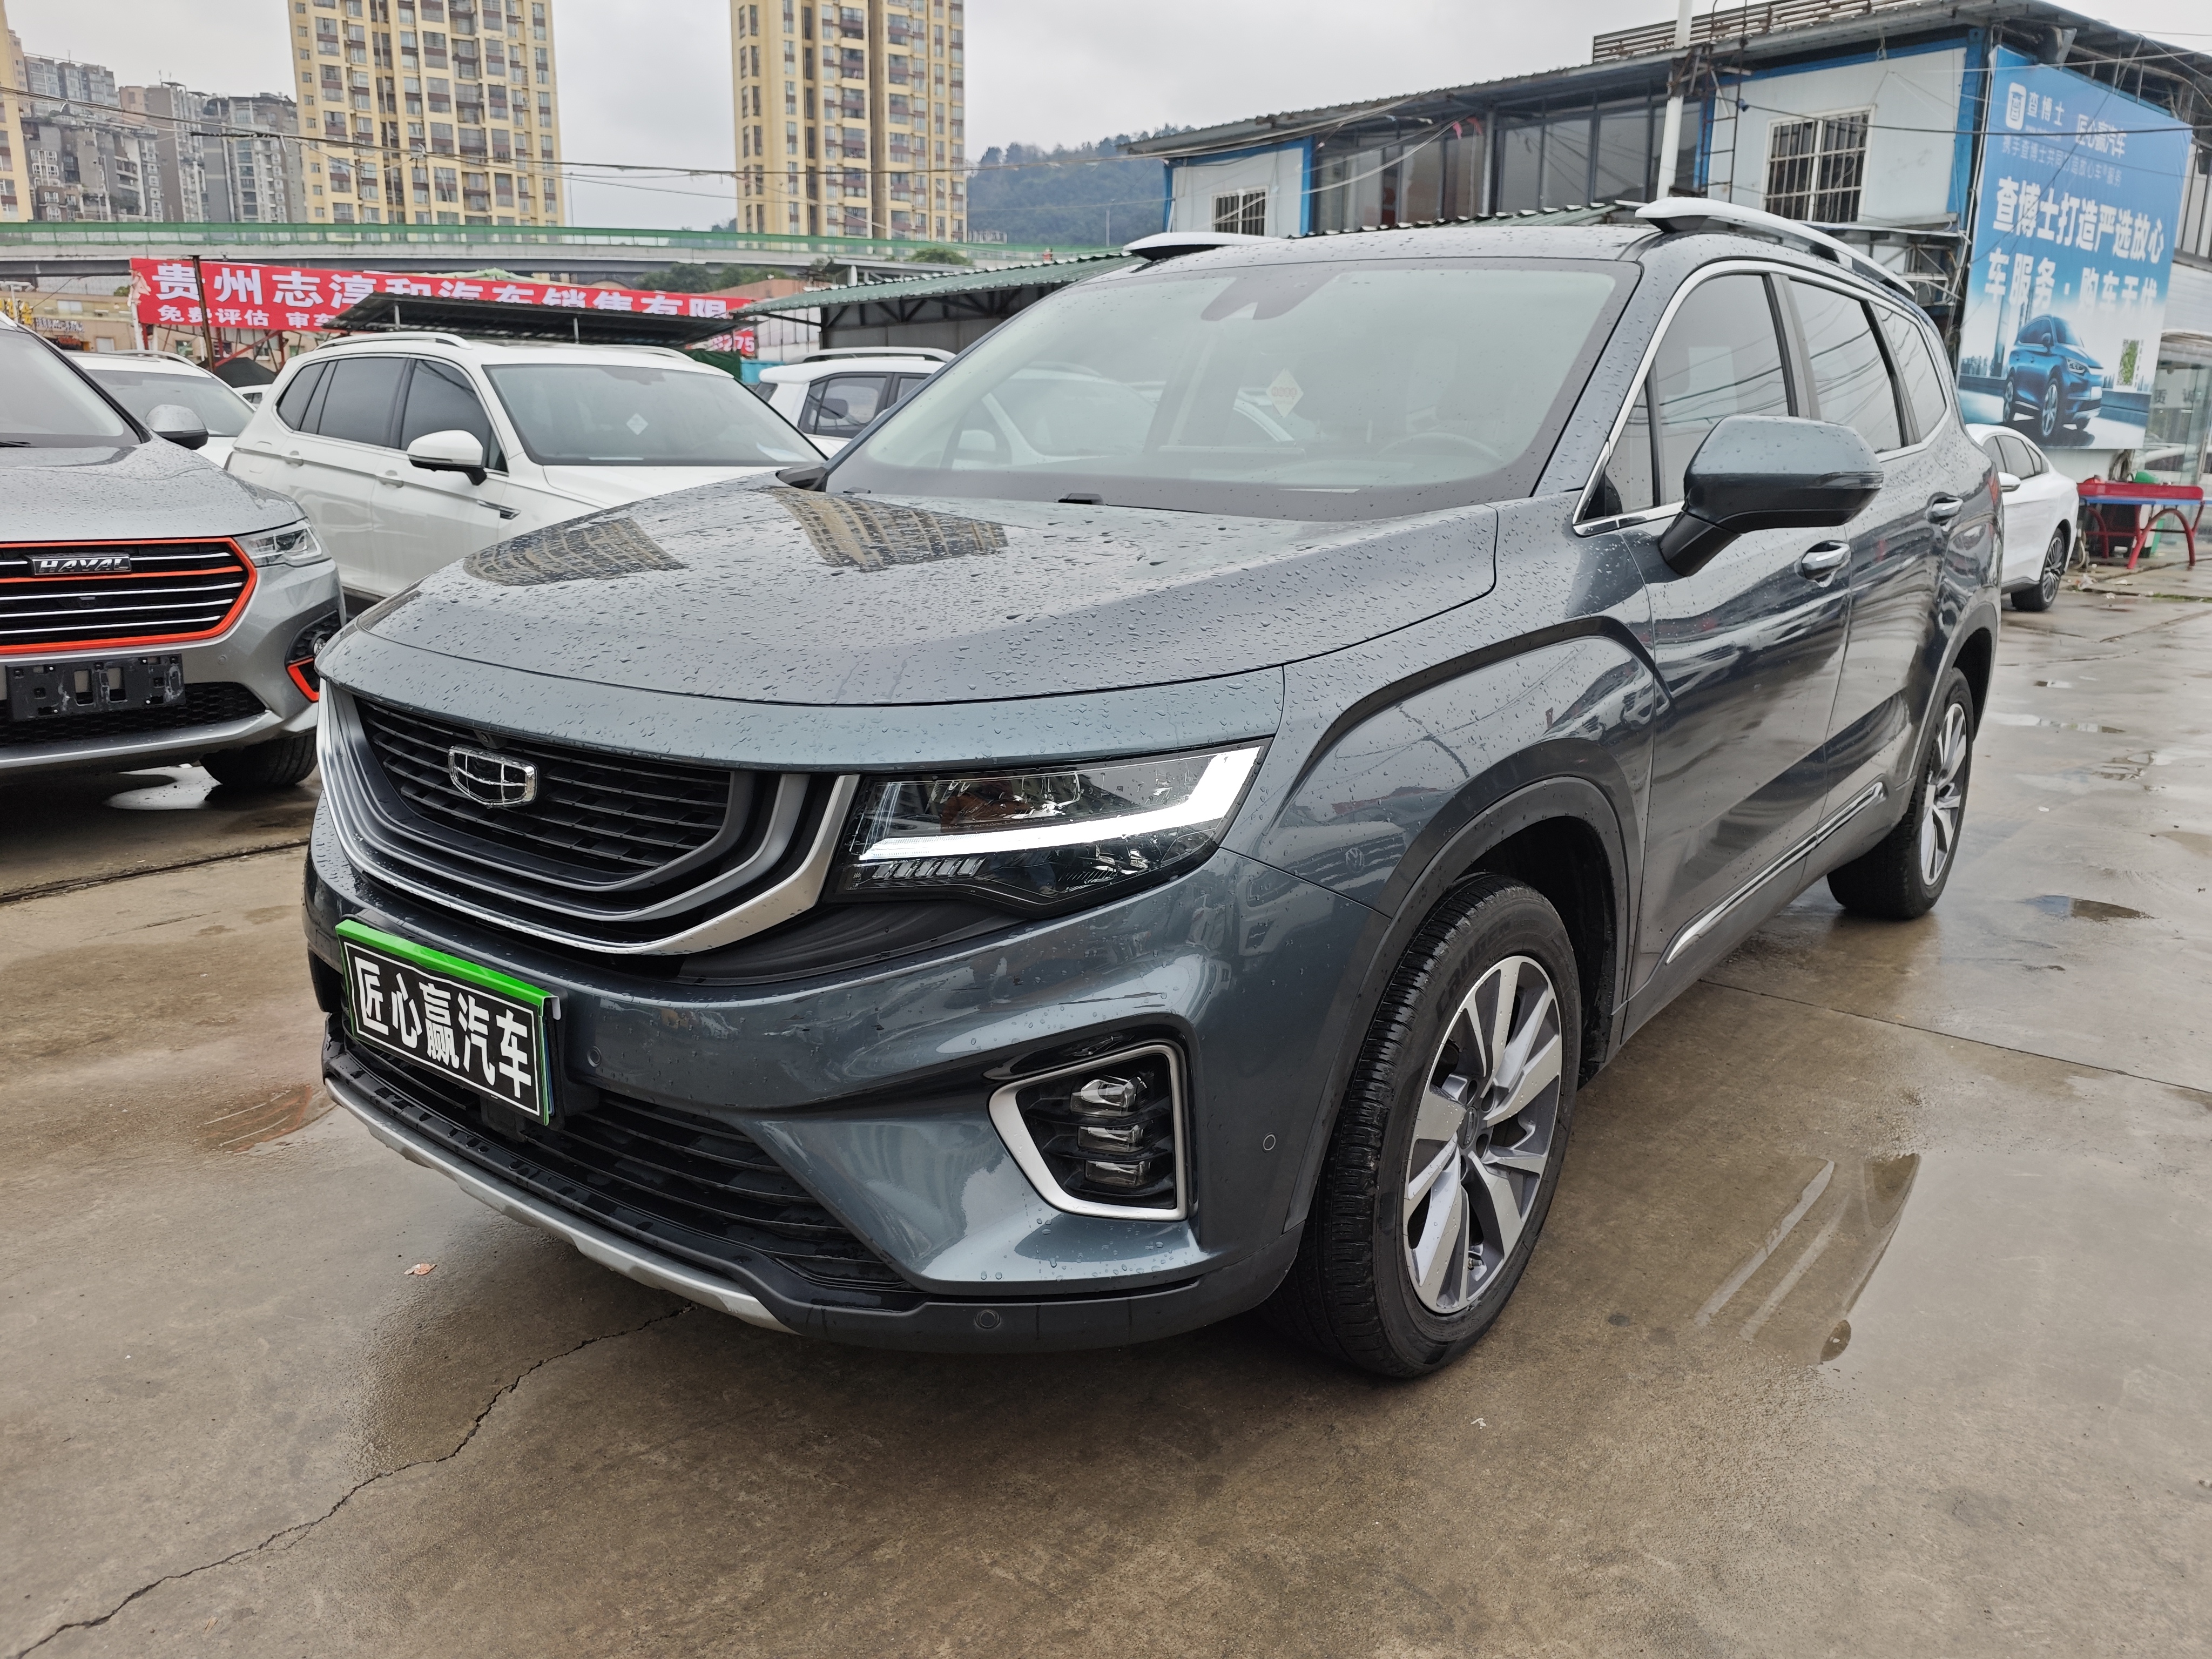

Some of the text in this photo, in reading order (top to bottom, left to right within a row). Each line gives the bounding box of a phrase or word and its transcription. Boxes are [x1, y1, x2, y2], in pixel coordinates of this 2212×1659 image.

[1993, 176, 2164, 265] 查博士打造严选放心
[157, 305, 270, 327] 免费评估
[38, 558, 129, 573] HAVAL
[354, 956, 532, 1098] 匠心赢汽车
